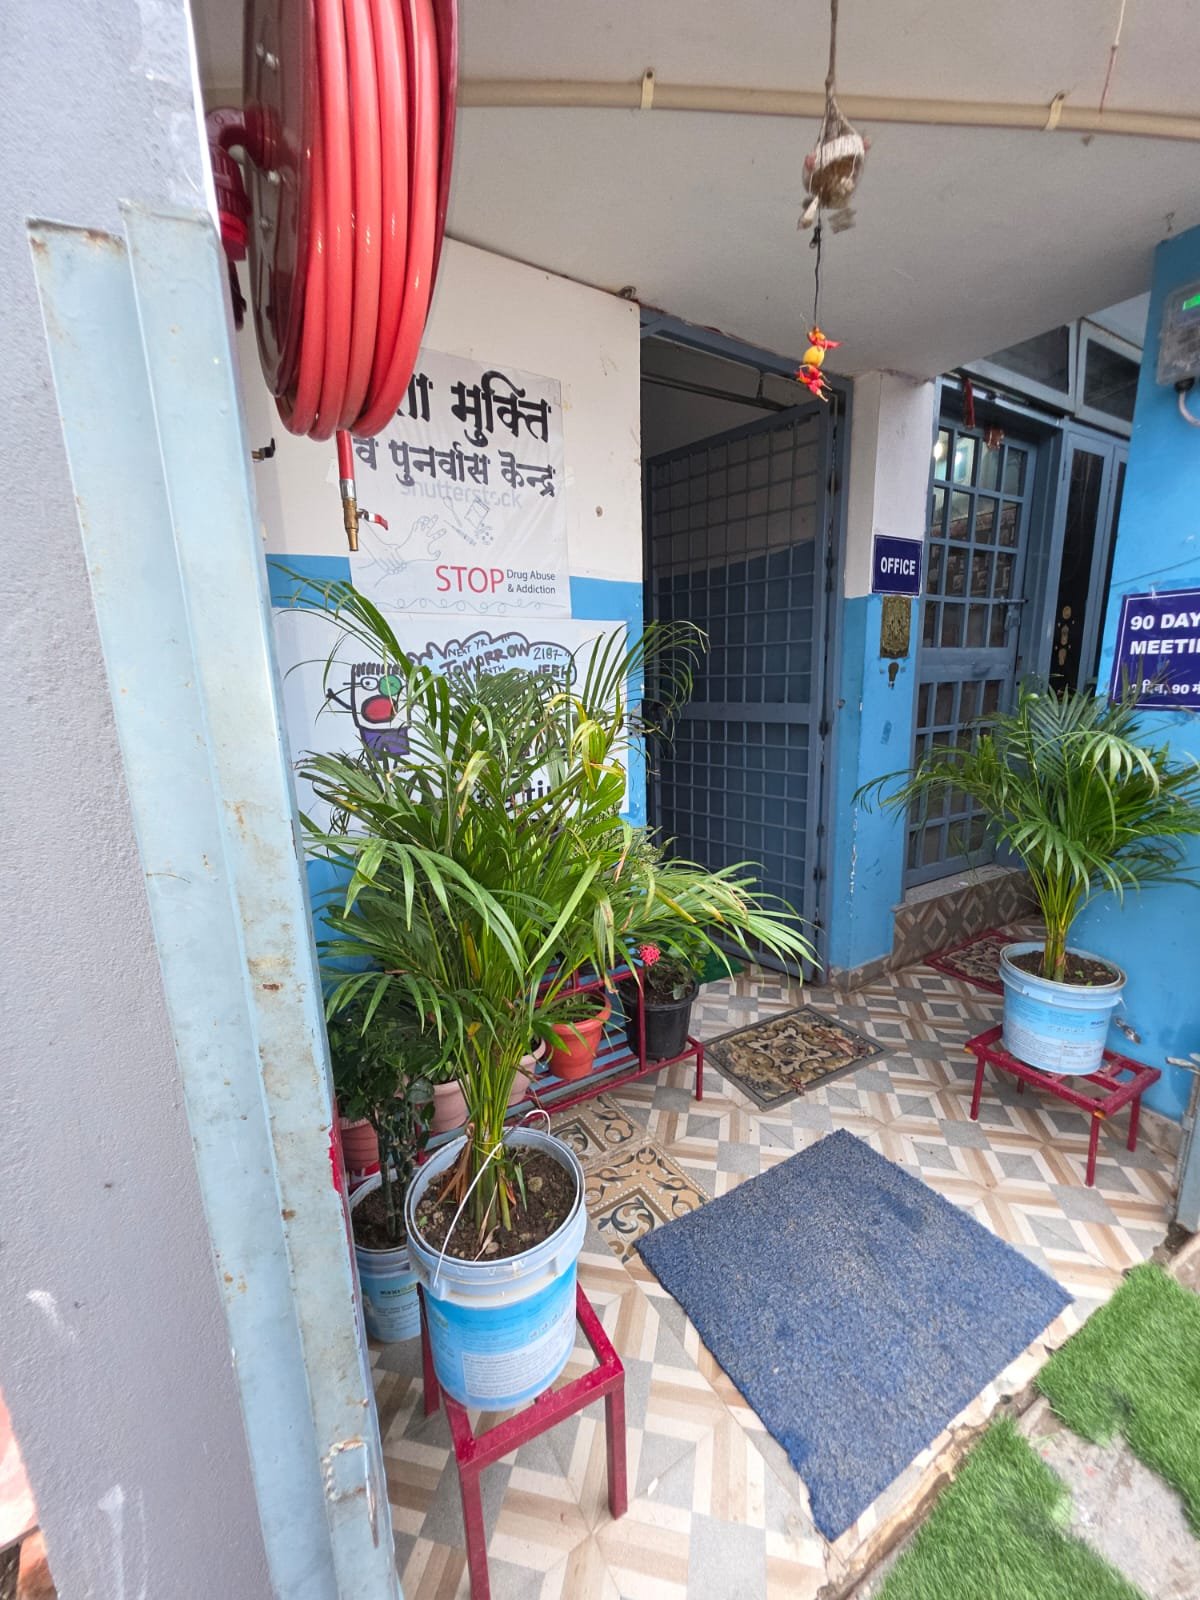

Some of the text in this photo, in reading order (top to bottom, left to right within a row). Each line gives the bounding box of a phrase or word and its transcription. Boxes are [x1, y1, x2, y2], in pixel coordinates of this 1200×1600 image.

[451, 370, 552, 448] मुक्ति
[388, 439, 491, 486] पुनर्वास
[880, 556, 916, 576] OFFICE
[435, 565, 505, 593] STOP
[506, 569, 556, 582] Drug Abuse
[507, 583, 556, 595] & Addiction
[1130, 615, 1155, 630] 90
[448, 645, 471, 657] NEXT
[439, 642, 531, 679] TOMORROW
[1171, 684, 1190, 695] 90
